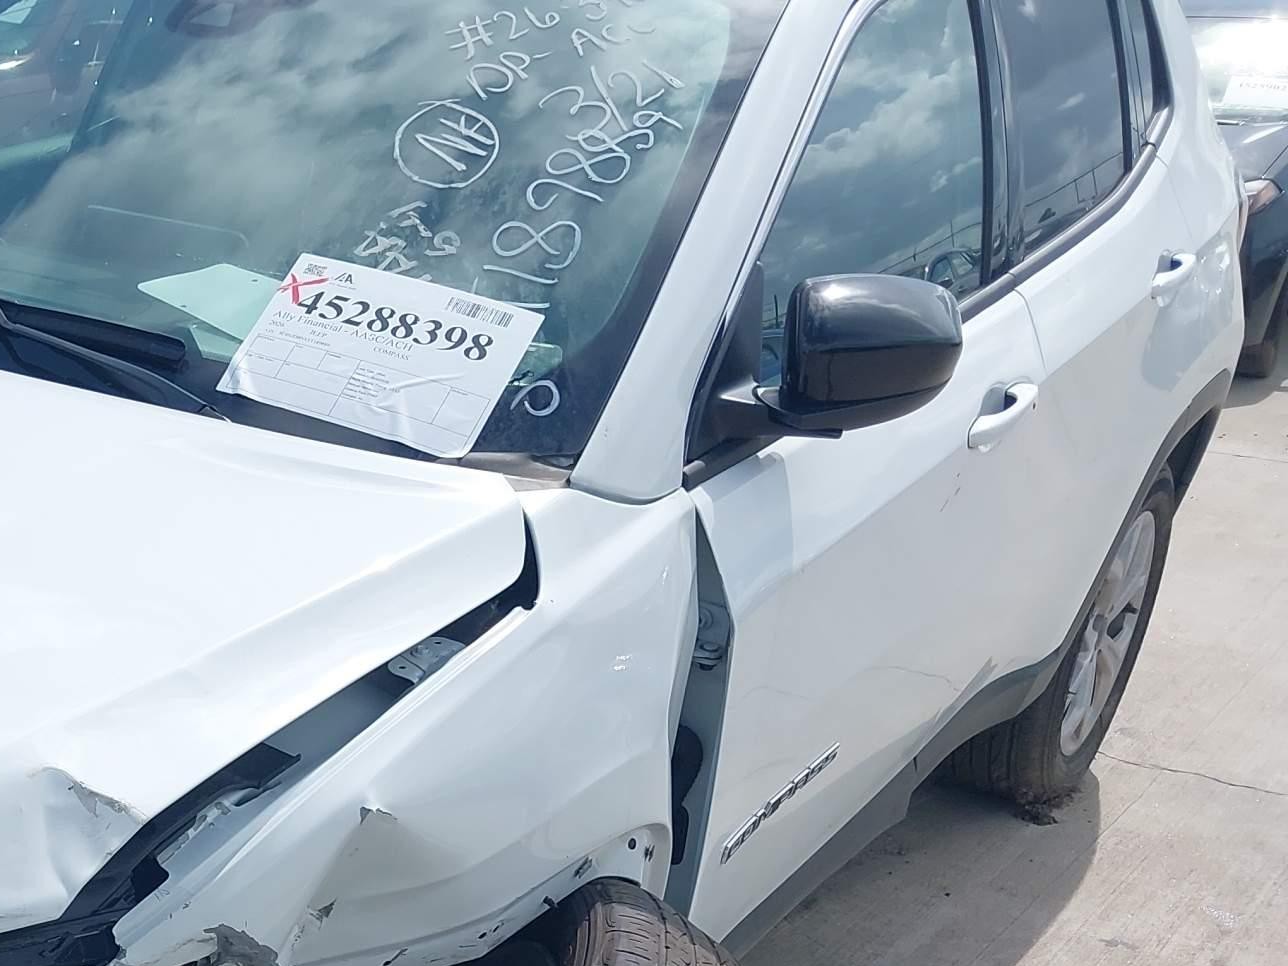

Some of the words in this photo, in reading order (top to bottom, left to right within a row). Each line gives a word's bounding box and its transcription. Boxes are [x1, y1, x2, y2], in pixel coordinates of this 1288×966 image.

[272, 311, 296, 322] Ally
[297, 315, 344, 333] Financial
[297, 291, 494, 361] 45288398
